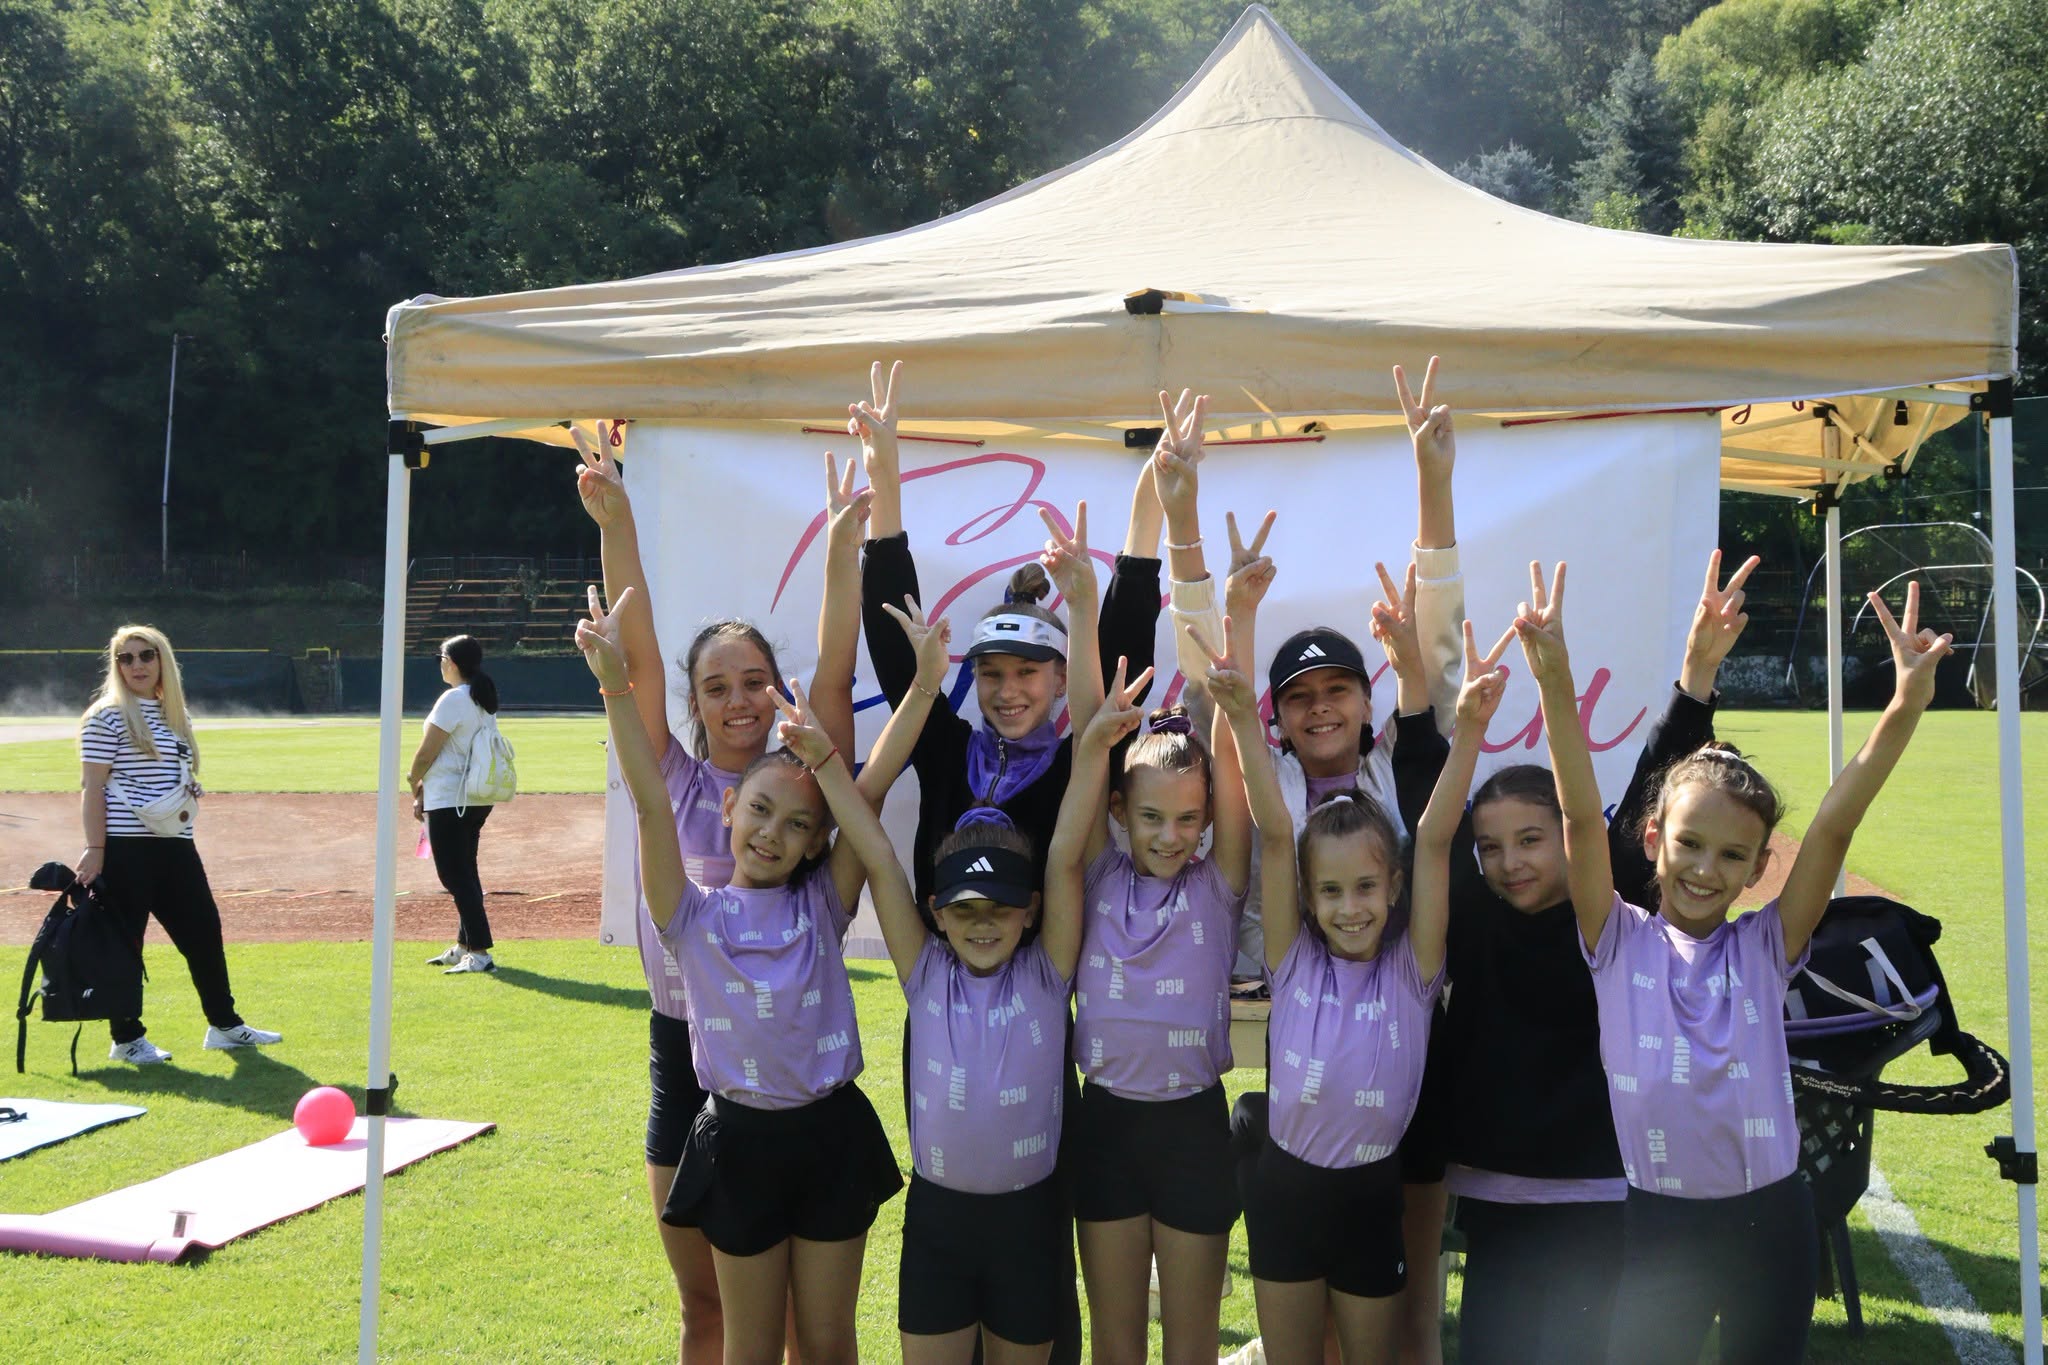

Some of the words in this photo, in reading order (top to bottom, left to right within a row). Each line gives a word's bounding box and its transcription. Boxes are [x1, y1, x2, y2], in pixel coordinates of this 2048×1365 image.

[726, 981, 746, 994] RGC
[1156, 978, 1184, 995] RGC
[1632, 972, 1656, 990] RGC
[752, 979, 775, 1020] PIRIN
[801, 988, 822, 1009] RGC
[704, 1018, 732, 1032] PIRIN
[816, 1030, 850, 1055] PIRIN
[1168, 1030, 1207, 1048] PIRIN
[1639, 1034, 1663, 1050] RGC
[1091, 1037, 1104, 1067] RGC
[1672, 1036, 1691, 1085] PIRIN
[743, 1058, 760, 1088] RGC
[1301, 1058, 1326, 1106] PIRIN
[949, 1066, 967, 1112] PIRIN
[1000, 1085, 1027, 1107] RGC
[1355, 1090, 1385, 1108] RGC
[1013, 1132, 1048, 1160] PIRIN
[1647, 1128, 1667, 1163] RGC
[930, 1146, 945, 1178] RGC
